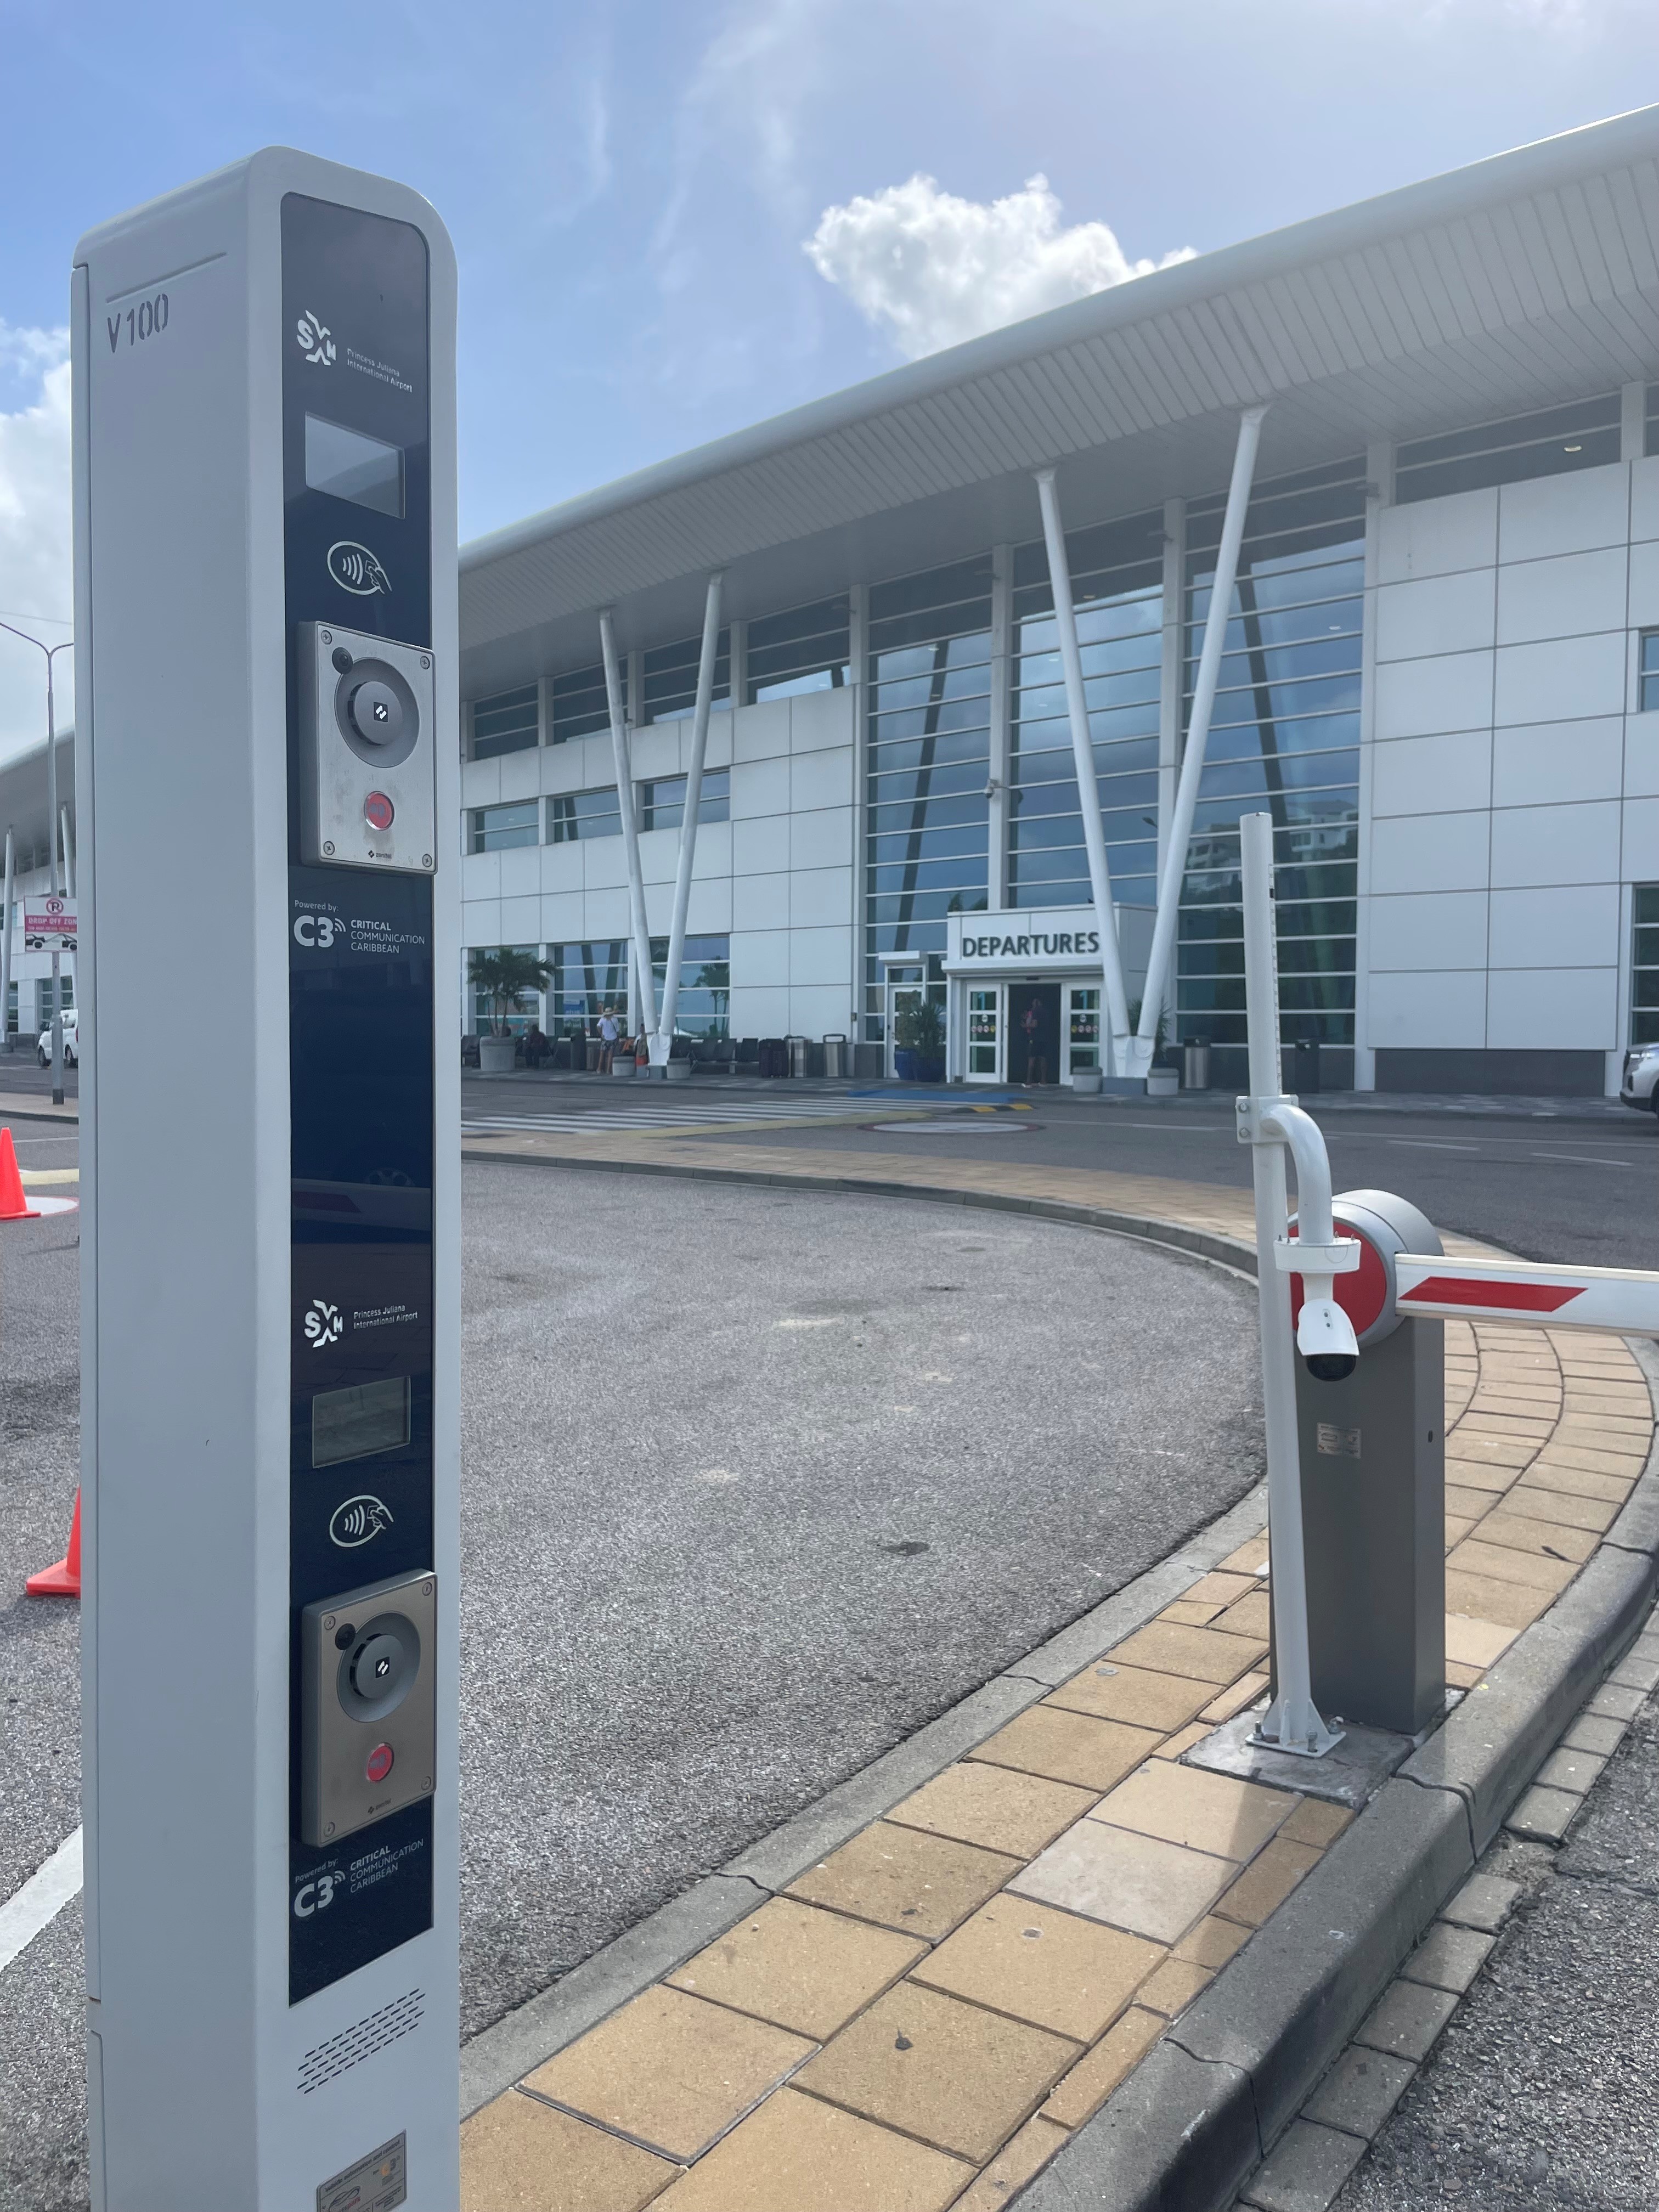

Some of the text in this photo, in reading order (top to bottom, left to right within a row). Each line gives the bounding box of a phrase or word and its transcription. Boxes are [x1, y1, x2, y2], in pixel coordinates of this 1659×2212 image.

[347, 348, 400, 377] Princess Juliana
[347, 358, 413, 392] International Airport
[295, 900, 339, 912] Powered by:
[294, 915, 334, 948] C3
[351, 919, 392, 931] CRITICAL
[351, 931, 425, 944] COMMUNICATION
[351, 942, 399, 953] CARIBBEAN
[963, 932, 1099, 957] DEPARTURES
[354, 1305, 405, 1319] Princess Juliana
[354, 1311, 418, 1329] International Airport
[295, 1858, 338, 1884] Powered by:
[350, 1846, 391, 1871] CRITICAL
[350, 1838, 424, 1882] COMMUNICATION
[350, 1863, 399, 1893] CARIBBEAN
[294, 1876, 334, 1917] C3
